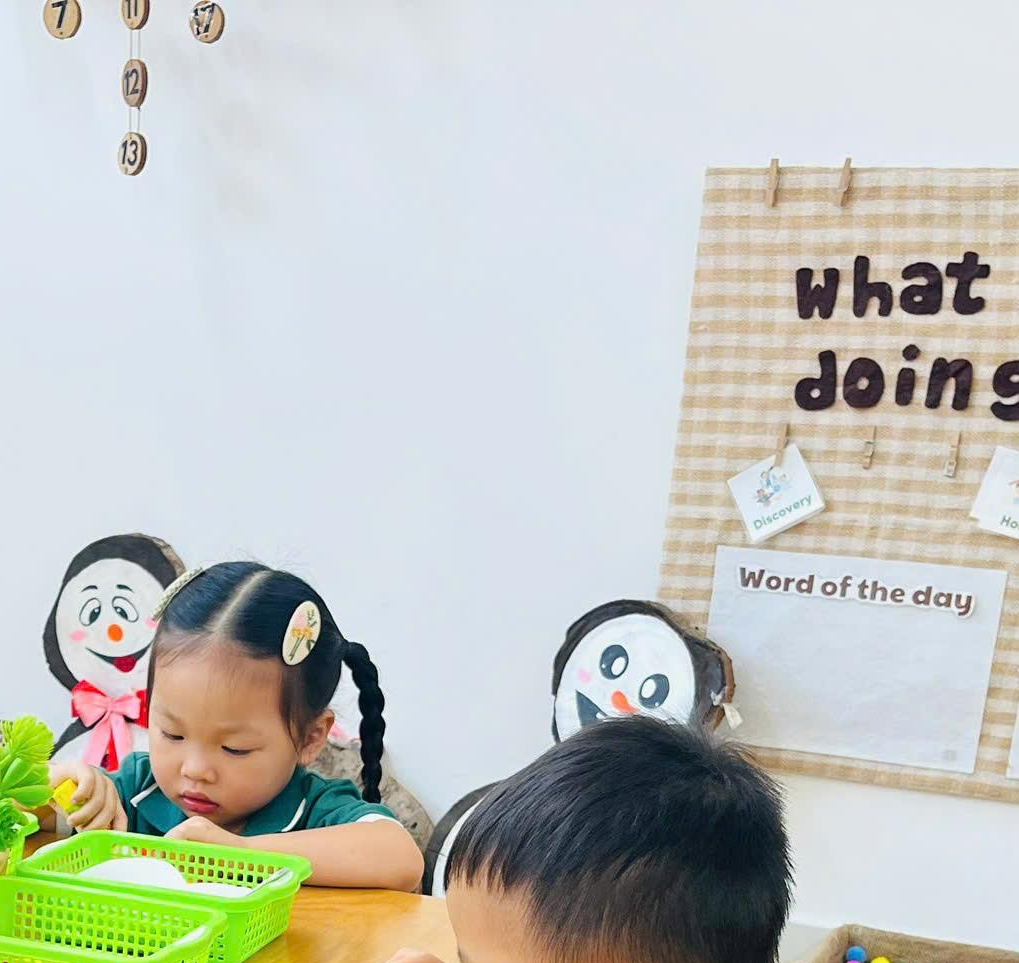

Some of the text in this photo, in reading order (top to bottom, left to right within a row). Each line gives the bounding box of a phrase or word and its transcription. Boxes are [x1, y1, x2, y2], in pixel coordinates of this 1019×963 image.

[123, 68, 140, 96] 12
[121, 140, 139, 166] 13
[794, 344, 1019, 421] doing
[752, 494, 813, 531] Discovery
[999, 513, 1019, 530] Ho
[739, 567, 973, 617] Word of the day
